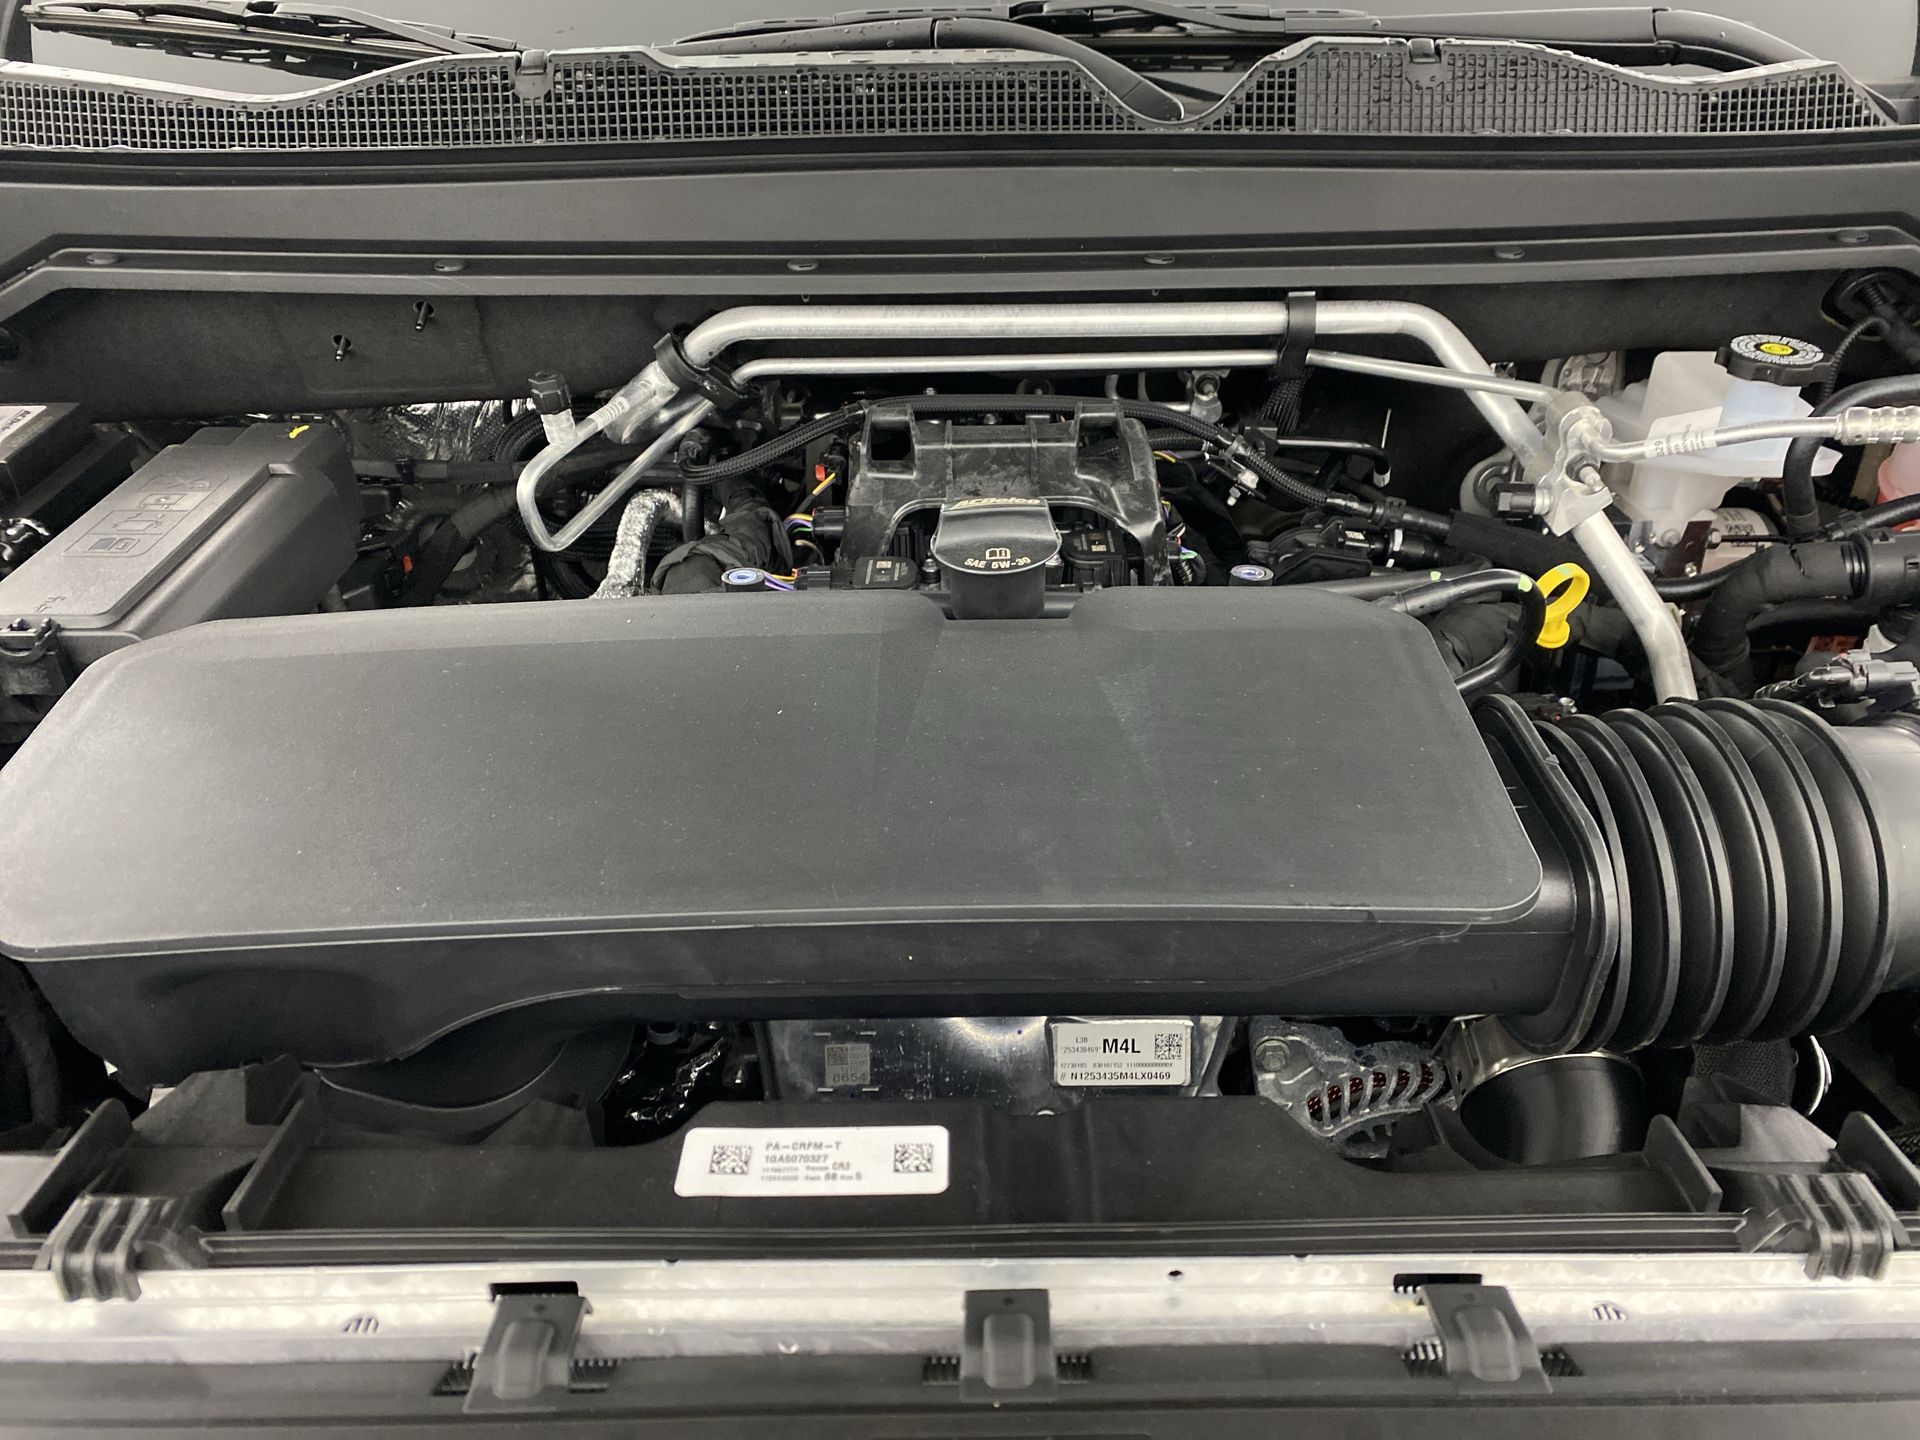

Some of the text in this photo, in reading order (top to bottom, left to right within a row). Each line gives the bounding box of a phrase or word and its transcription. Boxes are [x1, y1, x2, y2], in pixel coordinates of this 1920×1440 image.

[949, 497, 1041, 510] ACDelco
[964, 556, 1032, 569] SAE 5W-30
[1102, 1038, 1141, 1054] M4L
